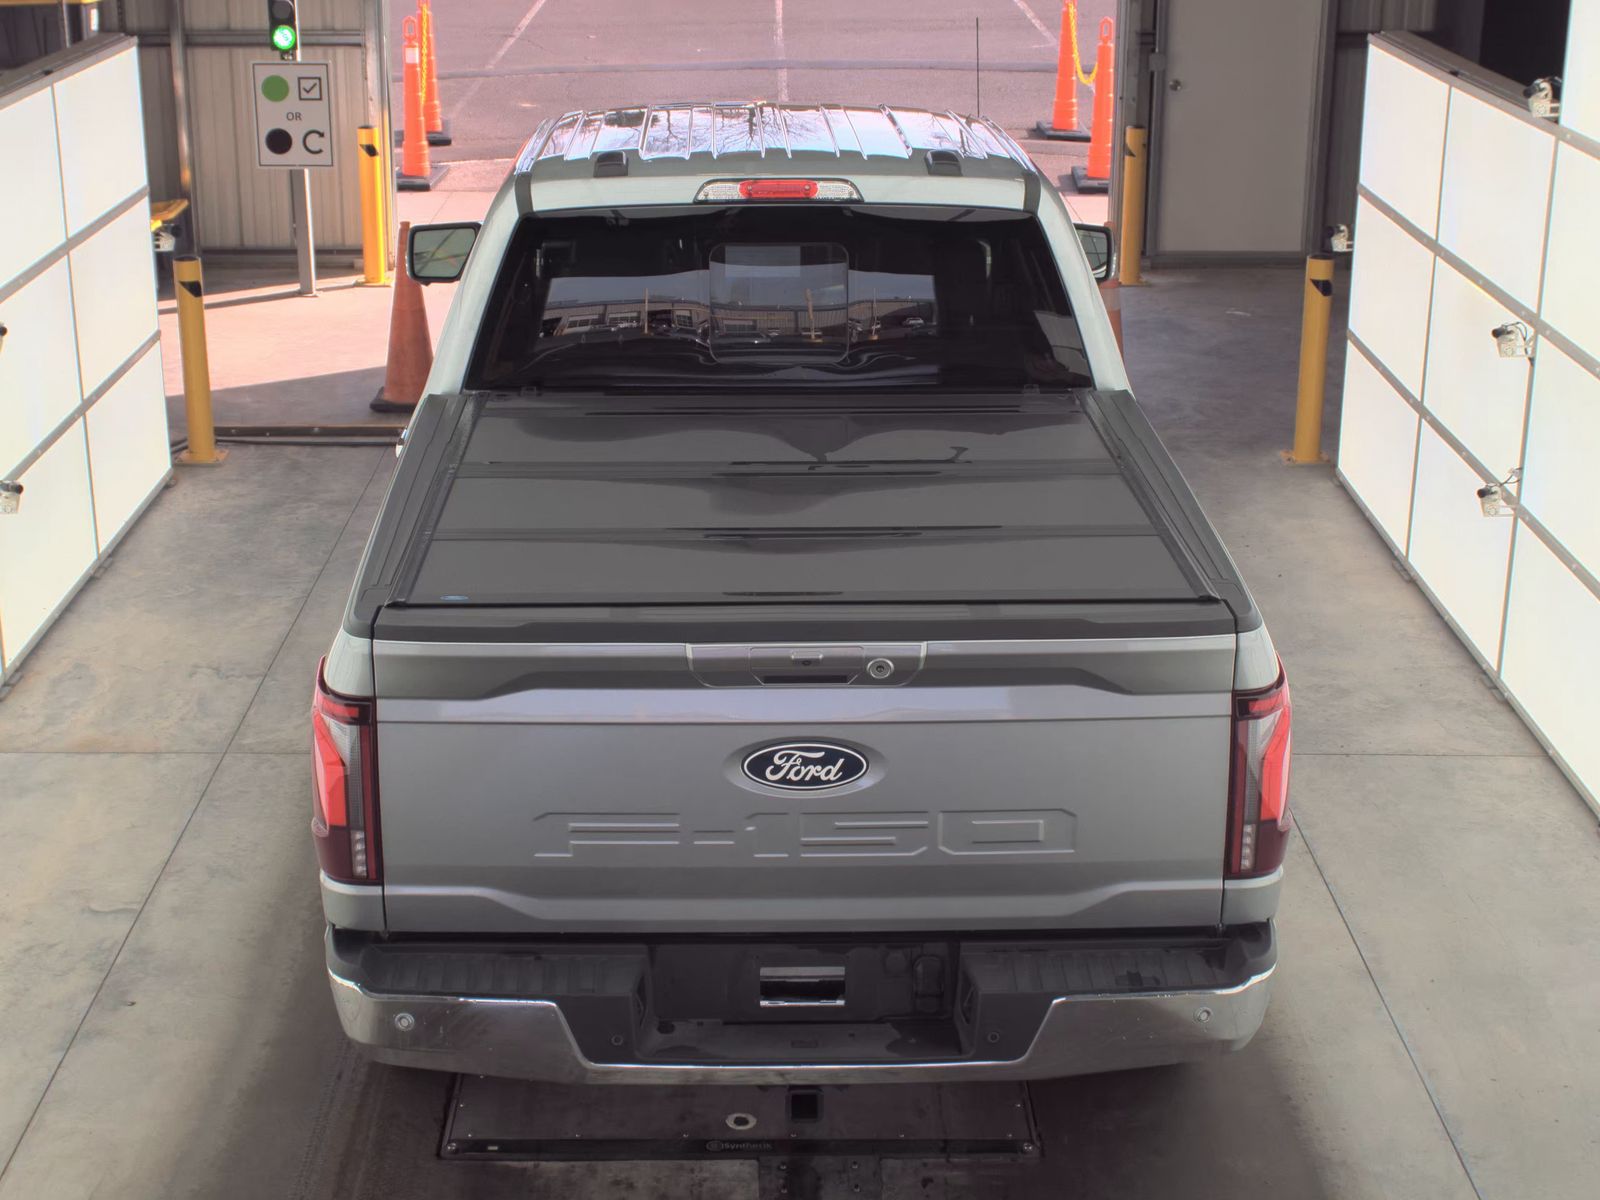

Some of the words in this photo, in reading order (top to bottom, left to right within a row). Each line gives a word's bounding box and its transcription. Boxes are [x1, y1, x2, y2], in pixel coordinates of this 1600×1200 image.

[286, 111, 302, 121] OR
[765, 750, 845, 781] Ford
[533, 810, 1077, 858] F-150
